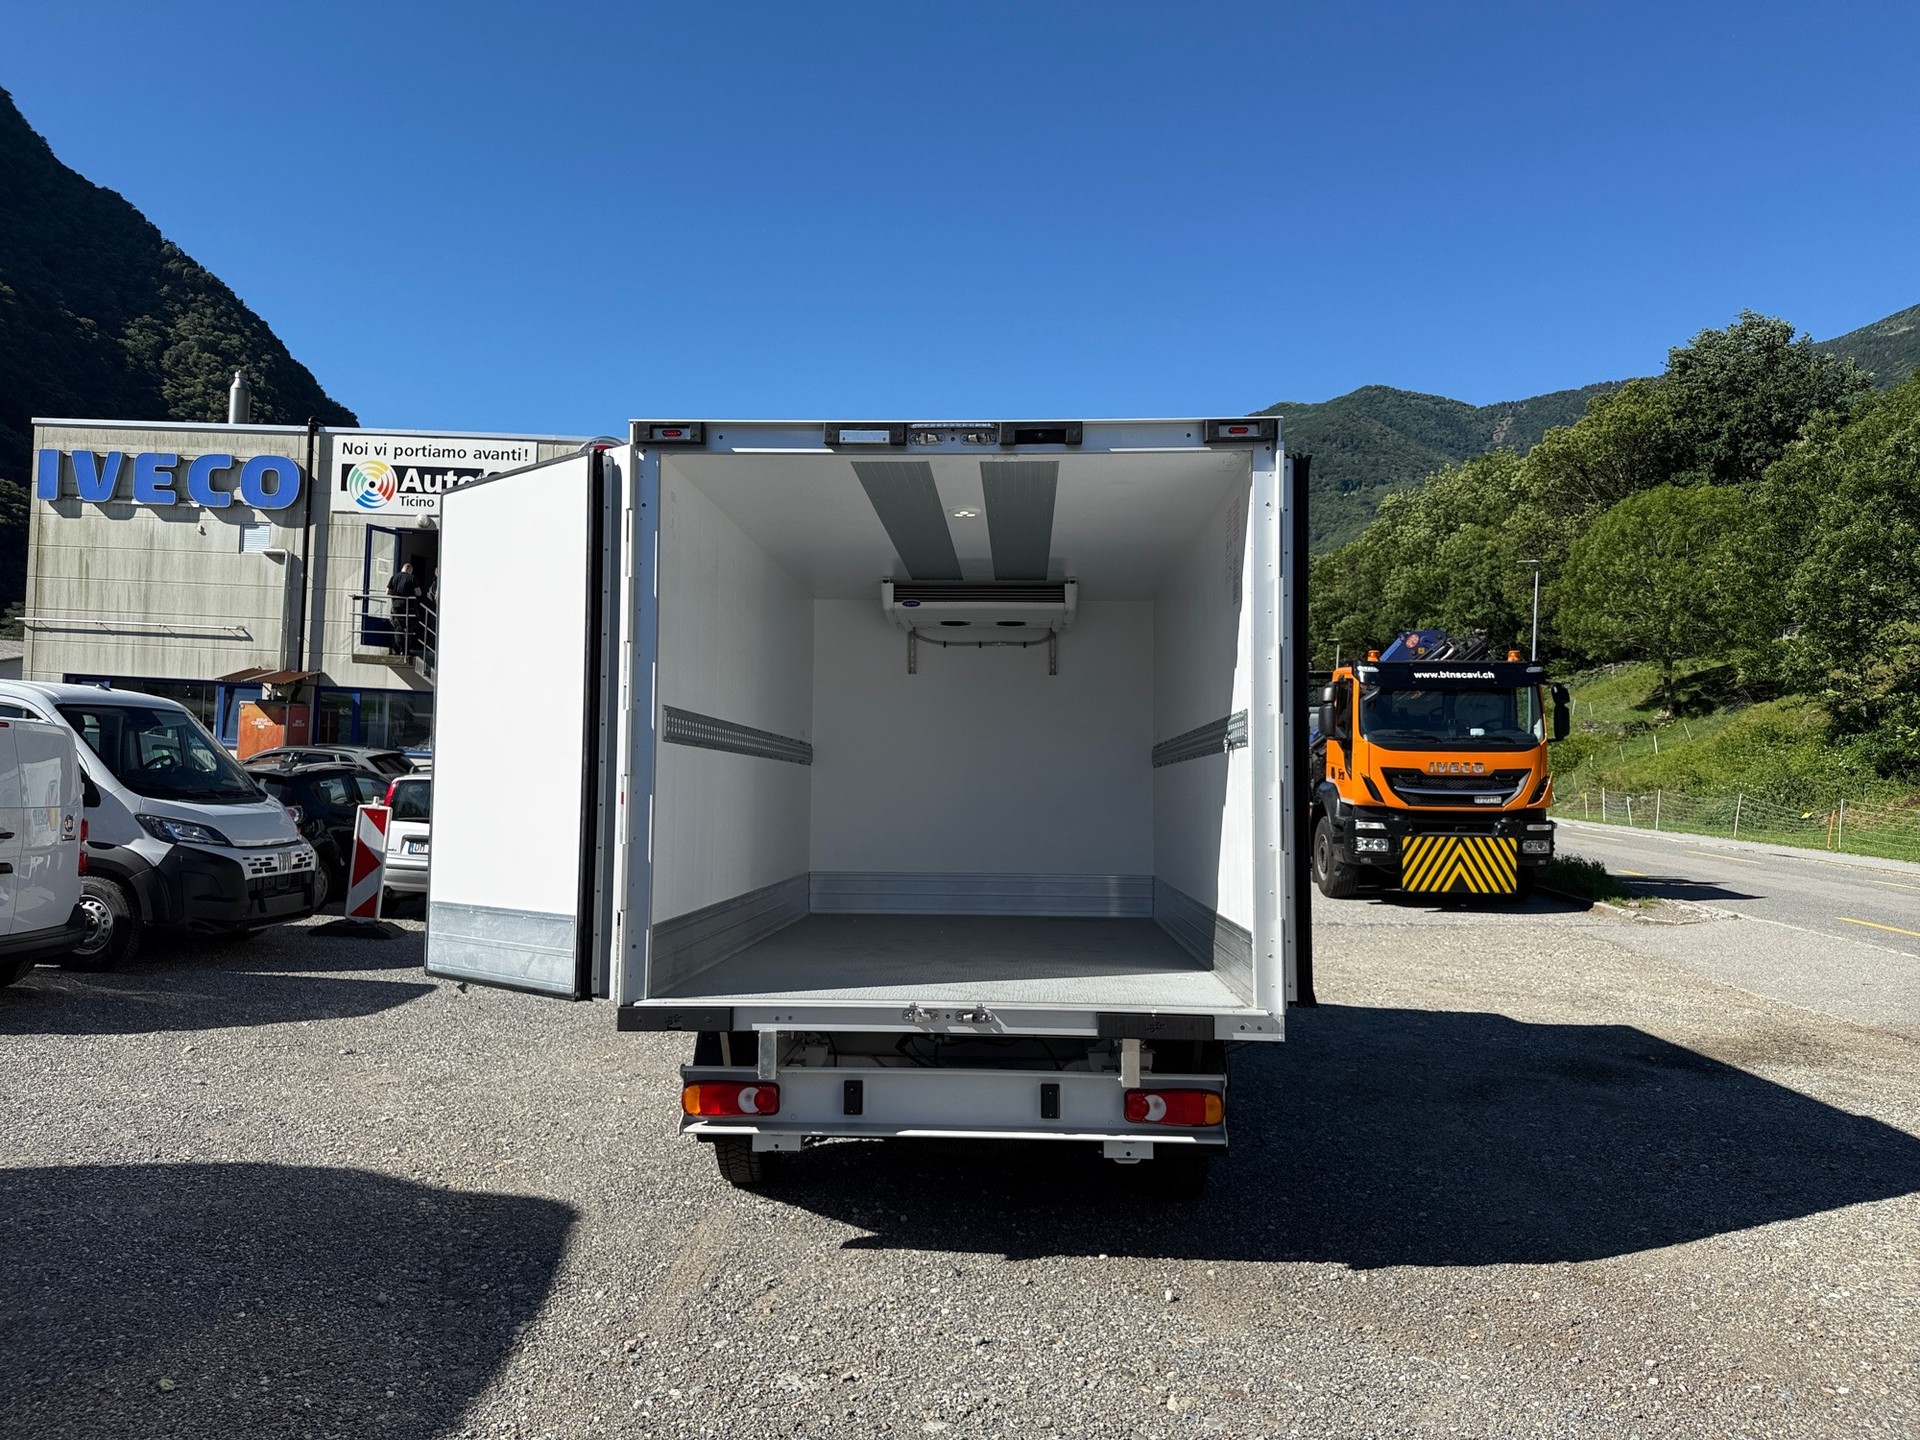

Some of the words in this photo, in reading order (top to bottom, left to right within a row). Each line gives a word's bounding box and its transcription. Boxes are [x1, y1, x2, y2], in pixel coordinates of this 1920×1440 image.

[341, 442, 369, 456] Noi
[374, 442, 388, 456] vi
[393, 443, 467, 460] portiamo
[473, 447, 529, 462] avanti!
[37, 448, 300, 510] IVECO
[400, 495, 435, 508] Ticino
[1413, 670, 1495, 679] www.btnscavi.ch
[1429, 761, 1486, 774] IVECO
